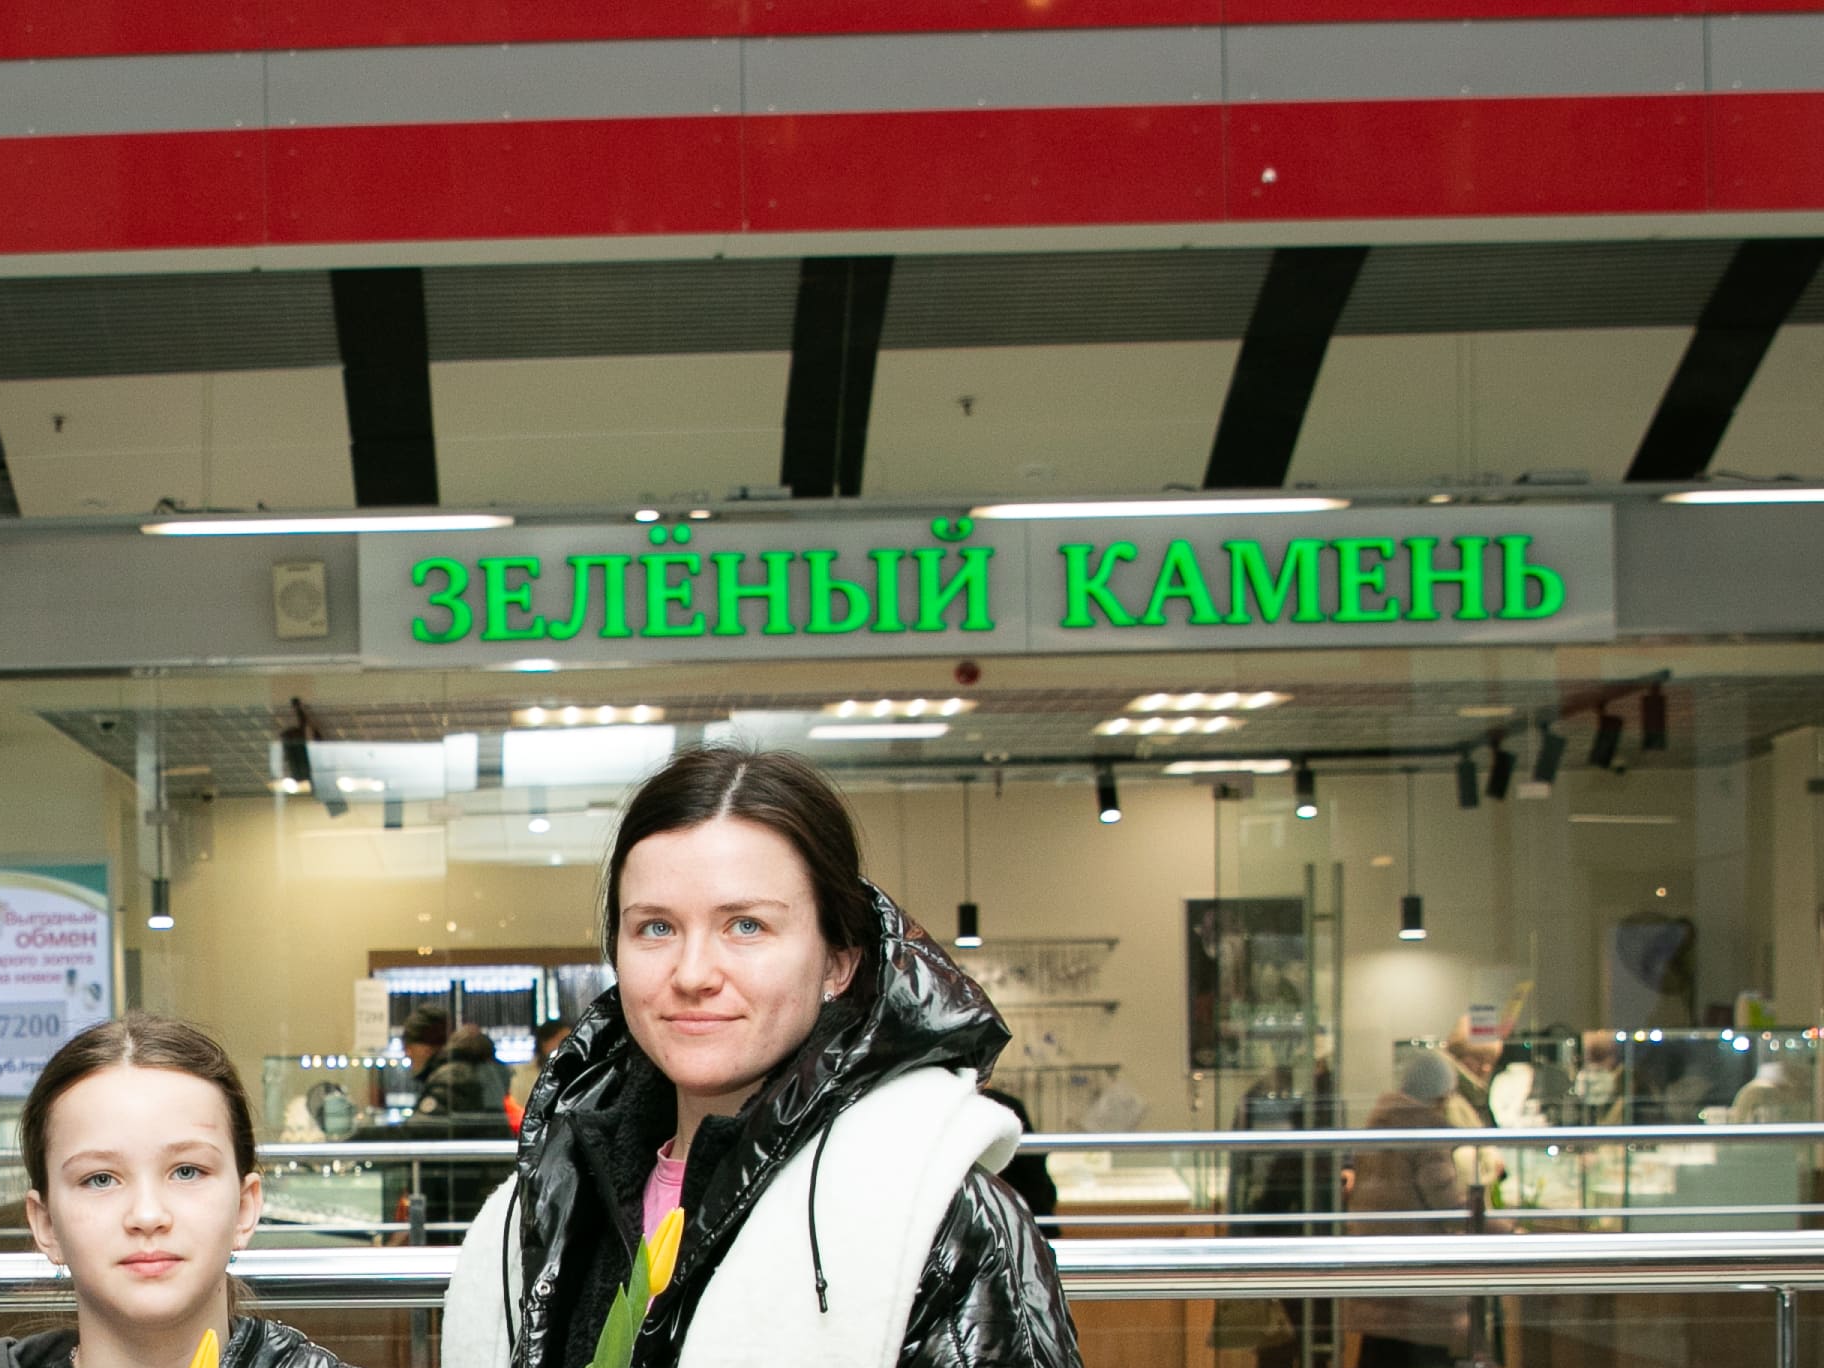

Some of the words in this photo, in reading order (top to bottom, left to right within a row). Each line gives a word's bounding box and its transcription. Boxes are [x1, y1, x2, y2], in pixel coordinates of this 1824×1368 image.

[411, 516, 996, 643] ЗЕЛЁНЫЙ
[1059, 534, 1567, 628] КАМЕНЬ
[16, 928, 97, 949] обмен
